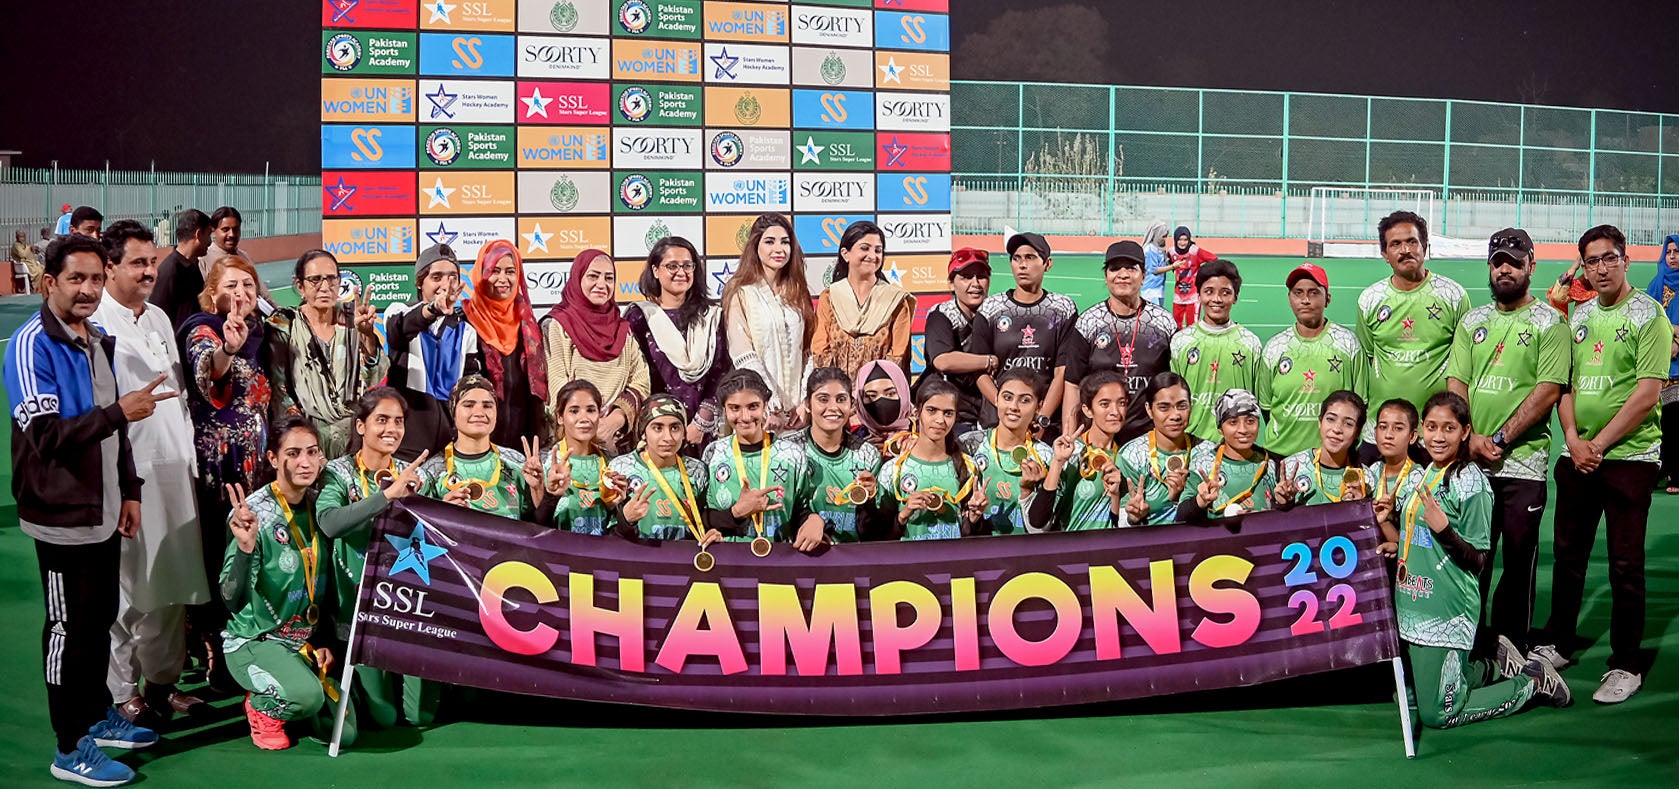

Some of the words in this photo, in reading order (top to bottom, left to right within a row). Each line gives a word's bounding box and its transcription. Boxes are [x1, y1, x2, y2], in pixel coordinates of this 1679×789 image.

[462, 2, 492, 16] SSL
[658, 3, 693, 14] Pakistan
[658, 12, 686, 22] Sports
[745, 10, 764, 22] UN
[658, 22, 696, 33] Academy
[708, 20, 764, 34] WOMEN
[798, 14, 865, 33] SOORTY
[369, 38, 407, 48] Pakistan
[369, 47, 398, 58] Sports
[525, 45, 601, 64] SOORTY
[655, 48, 675, 60] UN
[369, 57, 411, 68] Academy
[617, 60, 675, 73] WOMEN
[909, 64, 934, 77] SSL
[365, 88, 387, 99] UN
[659, 91, 694, 101] Pakistan
[324, 100, 387, 113] WOMEN
[558, 95, 588, 109] SSL
[659, 99, 686, 109] Sports
[659, 109, 696, 119] Academy
[882, 100, 945, 118] SOORTY
[468, 133, 505, 142] Pakistan
[561, 135, 583, 146] UN
[750, 136, 784, 146] Pakistan
[468, 141, 497, 151] Sports
[620, 136, 694, 154] SOORTY
[750, 144, 776, 154] Sports
[829, 143, 855, 157] SSL
[468, 151, 508, 162] Academy
[522, 147, 583, 160] WOMEN
[750, 154, 786, 164] Academy
[659, 178, 694, 188] Pakistan
[747, 180, 766, 191] UN
[461, 185, 492, 198] SSL
[659, 187, 687, 196] Sports
[800, 181, 866, 198] SOORTY
[659, 197, 697, 207] Academy
[710, 193, 766, 204] WOMEN
[365, 227, 387, 240] UN
[883, 221, 944, 239] SOORTY
[560, 230, 588, 243] SSL
[324, 241, 387, 254] WOMEN
[370, 273, 408, 283] Pakistan
[912, 266, 937, 279] SSL
[370, 282, 400, 292] Sports
[370, 292, 411, 302] Academy
[17, 396, 58, 428] didas
[1281, 536, 1358, 587] 20
[373, 581, 435, 618] SSL
[478, 554, 1261, 675] CHAMPIONS
[1287, 583, 1363, 636] 22
[382, 614, 415, 630] Super
[417, 621, 458, 639] League
